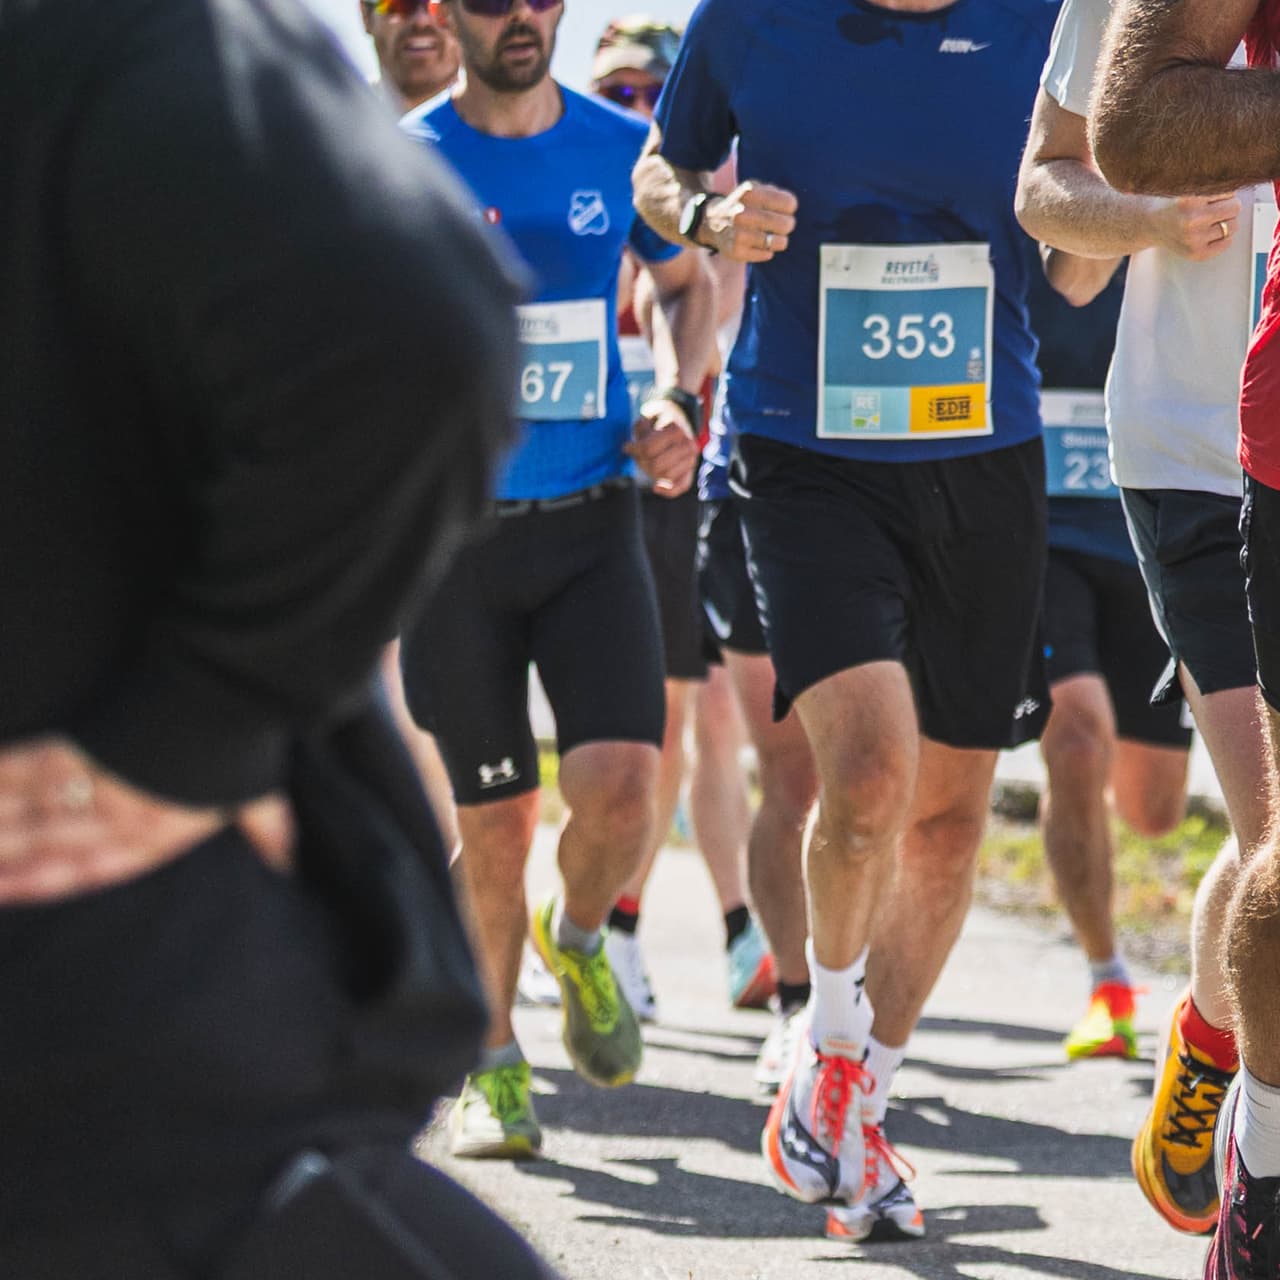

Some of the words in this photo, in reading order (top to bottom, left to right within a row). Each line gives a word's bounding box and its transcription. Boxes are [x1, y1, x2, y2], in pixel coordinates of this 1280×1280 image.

[862, 312, 956, 359] 353
[520, 361, 573, 403] 67
[936, 400, 971, 417] EDH
